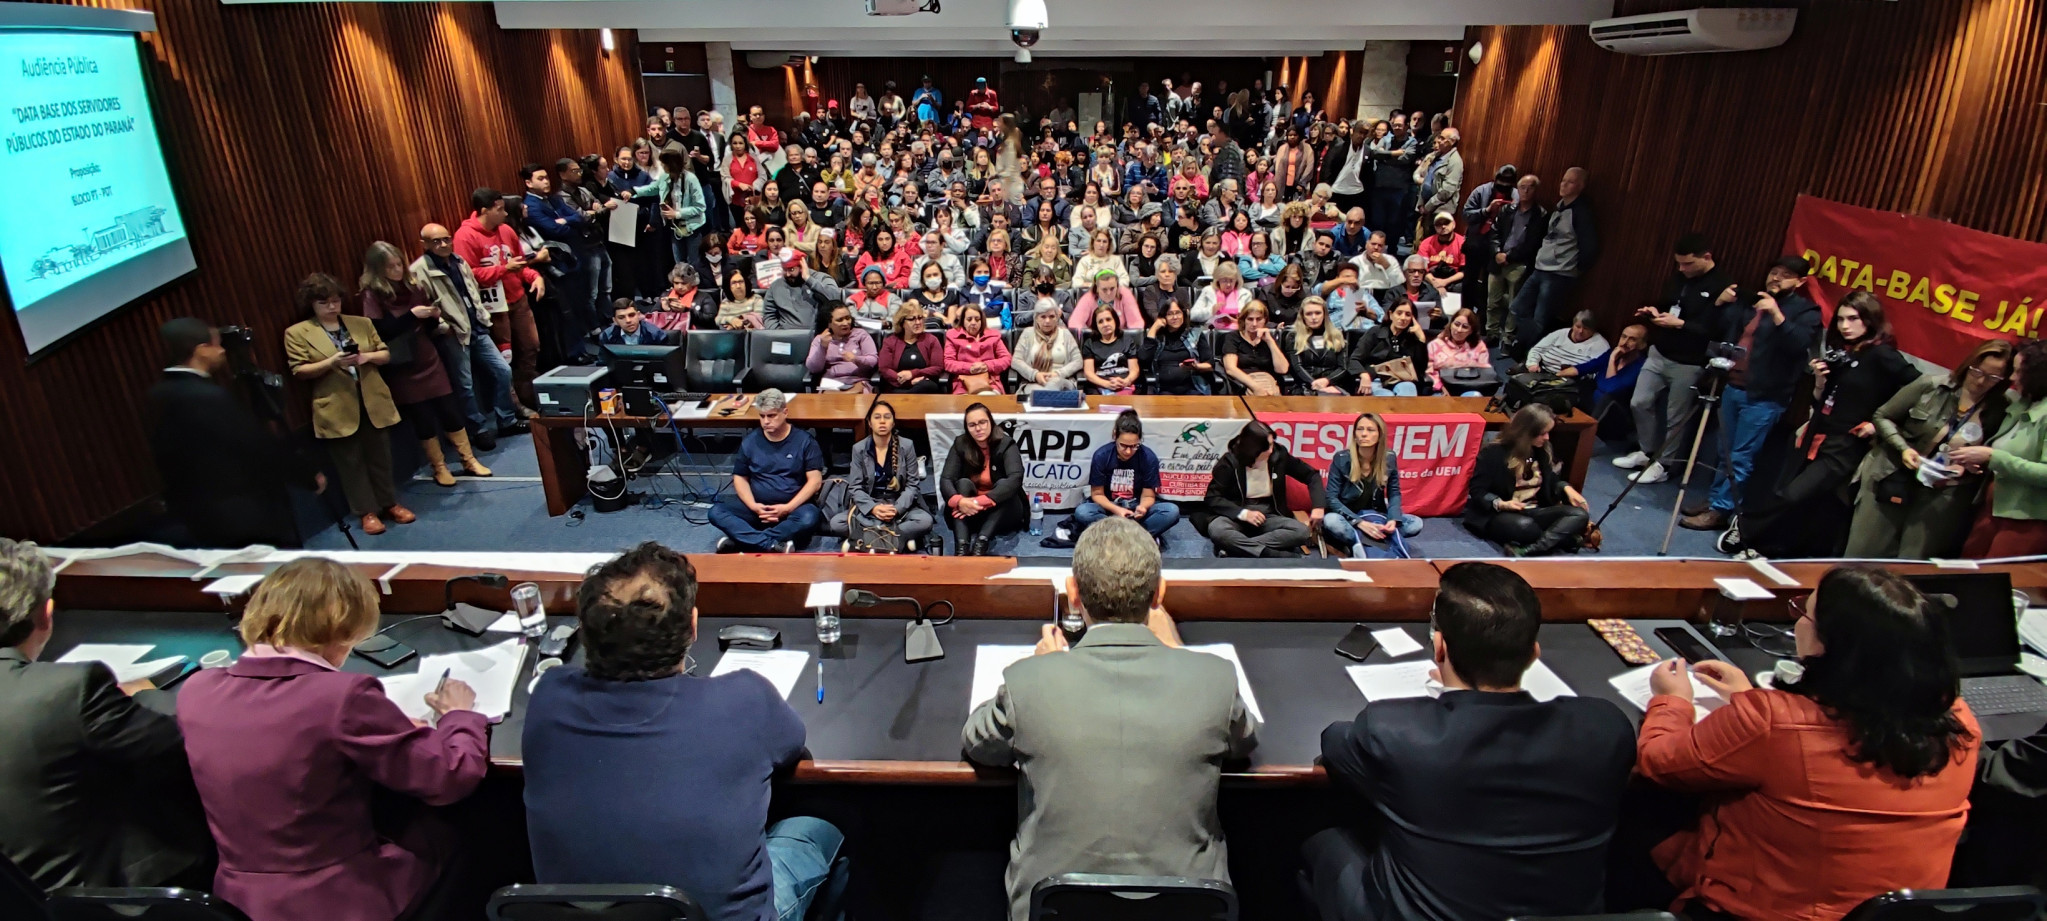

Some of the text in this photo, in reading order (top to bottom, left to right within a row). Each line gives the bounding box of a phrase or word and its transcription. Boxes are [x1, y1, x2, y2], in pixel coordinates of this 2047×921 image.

[22, 56, 99, 77] Audiência Pública
[40, 102, 61, 120] BASE
[60, 101, 78, 117] DOS
[78, 97, 121, 113] SERVIDORES
[6, 131, 49, 154] PÚBLICOS
[48, 129, 62, 146] DO
[61, 124, 91, 143] ESTADO
[91, 122, 105, 138] DO
[71, 192, 91, 206] BLOCO
[90, 189, 99, 201] PT
[1802, 248, 2045, 340] DATA-BASE JÁ!
[1016, 429, 1091, 463] APP
[1171, 445, 1189, 460] Em
[1025, 462, 1083, 481] ICATO
[1194, 460, 1213, 476] púb
[1421, 471, 1434, 479] da
[1435, 466, 1462, 477] UEM
[1111, 475, 1135, 484] SOMOS
